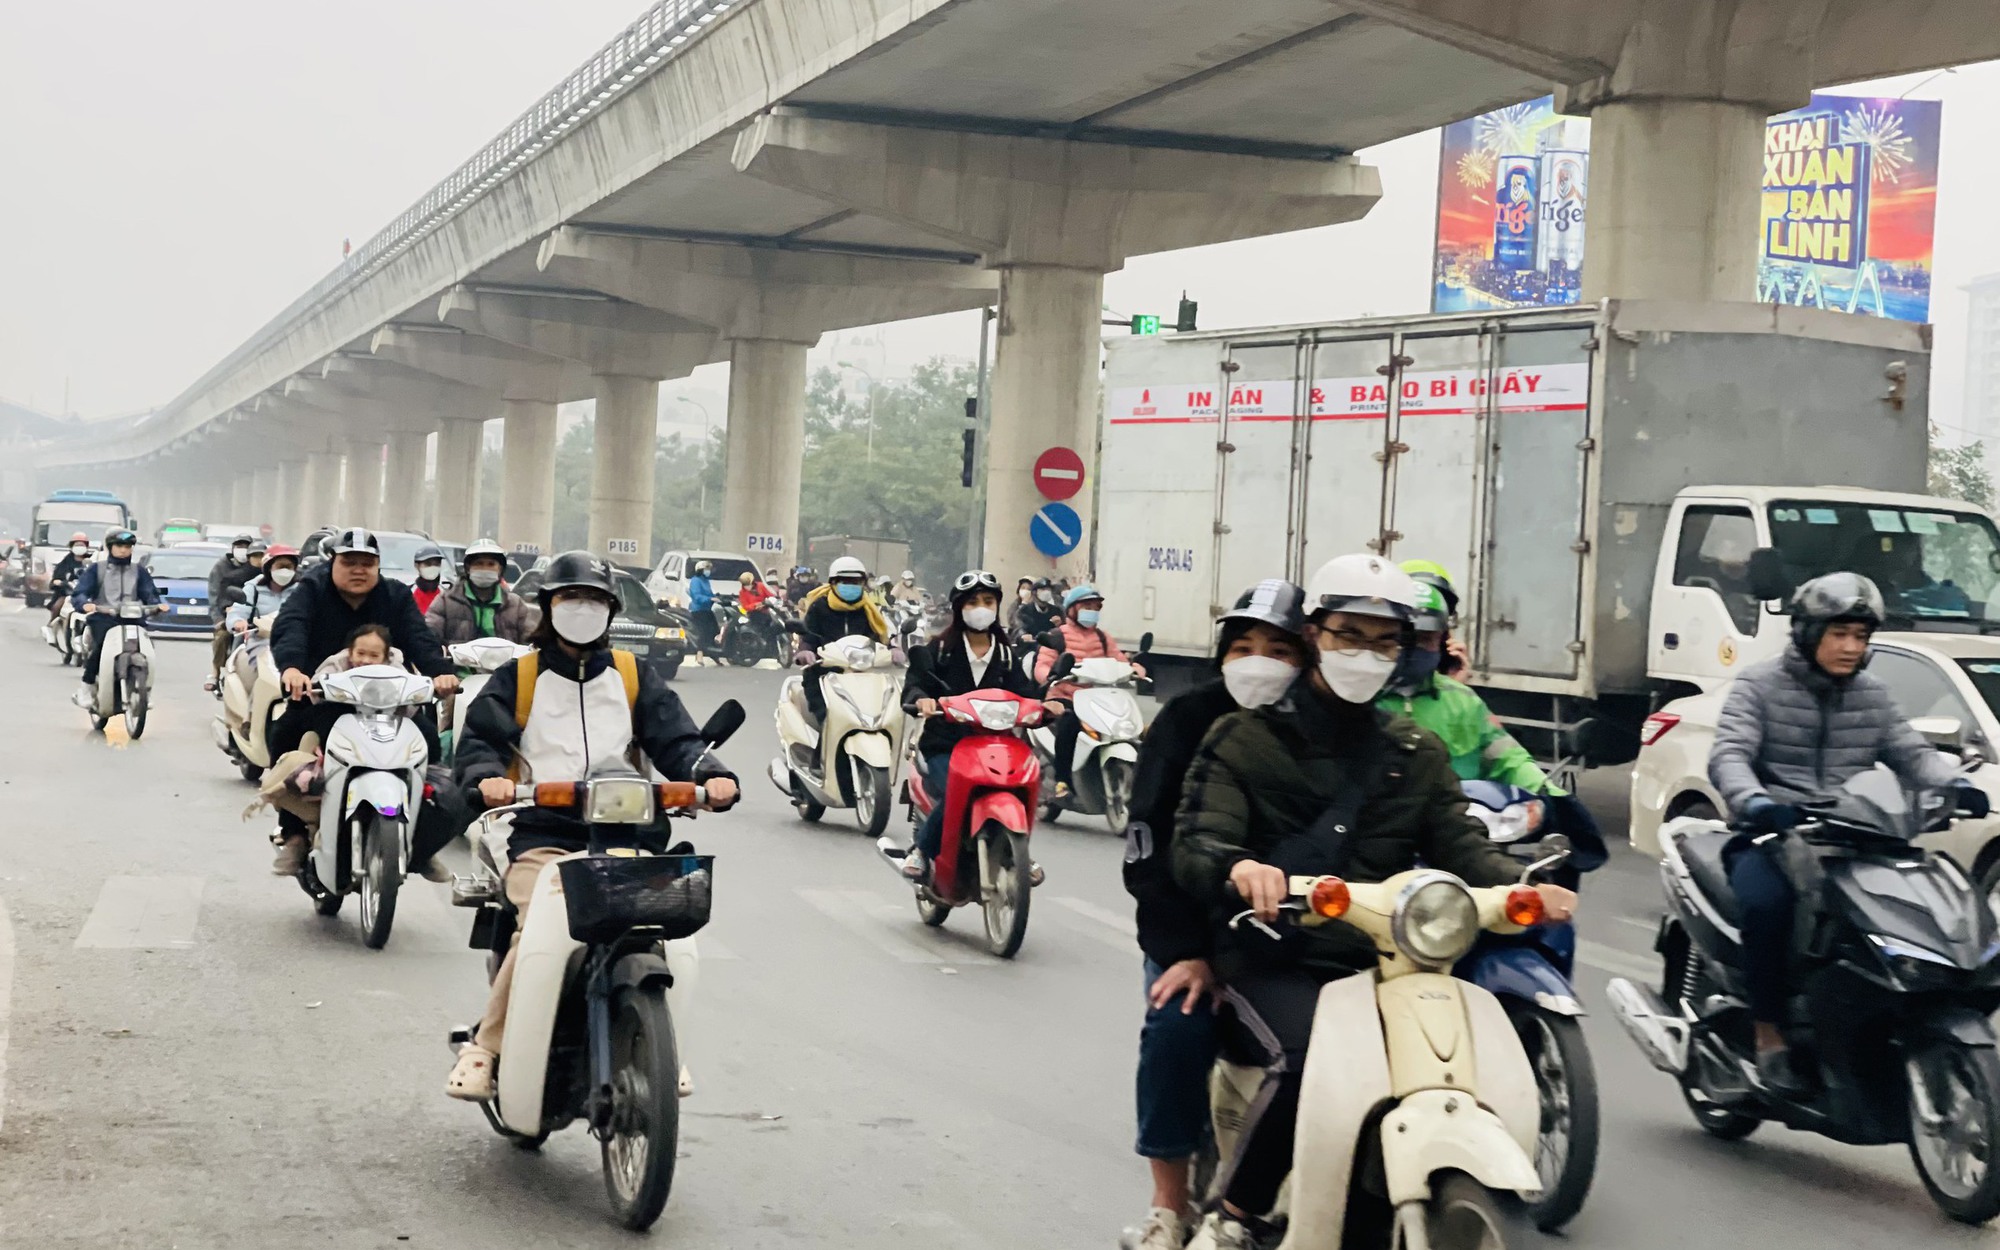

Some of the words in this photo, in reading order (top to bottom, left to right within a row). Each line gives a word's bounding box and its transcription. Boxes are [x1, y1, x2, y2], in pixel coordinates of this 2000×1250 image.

[1765, 118, 1826, 153] KHAI
[1763, 139, 1854, 187] XUÂN
[1188, 391, 1212, 407] IN
[1229, 383, 1263, 406] ẤN
[1310, 388, 1326, 404] &
[1430, 375, 1458, 398] BÌ
[1469, 369, 1542, 396] GIẤY
[609, 541, 637, 553] P185
[748, 535, 783, 551] P184
